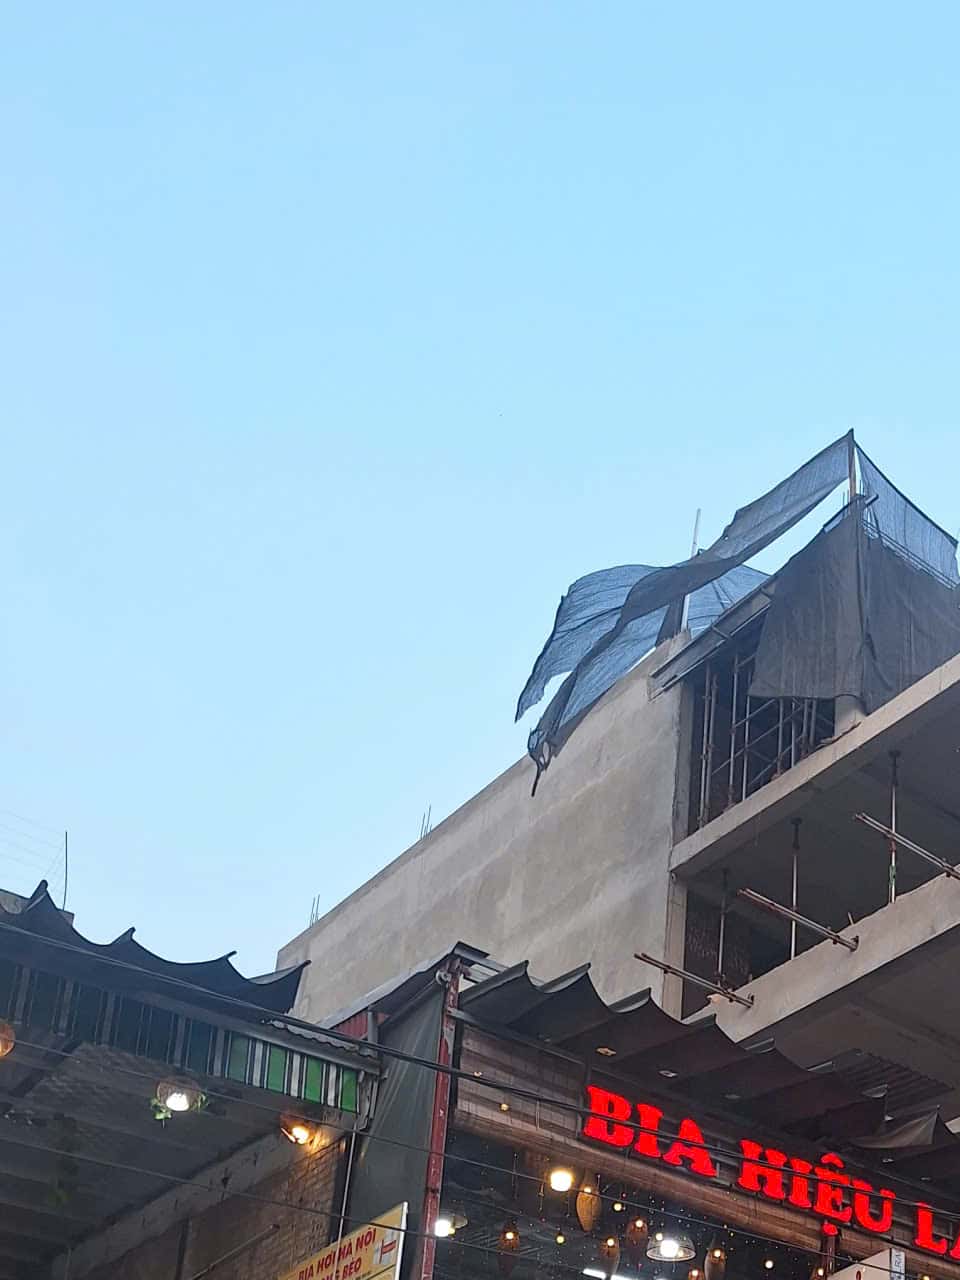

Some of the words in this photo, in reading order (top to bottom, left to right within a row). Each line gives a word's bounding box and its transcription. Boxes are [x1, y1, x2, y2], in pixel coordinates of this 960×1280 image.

[583, 1085, 717, 1177] BIA
[738, 1139, 896, 1235] HIỆU
[338, 1239, 353, 1261] HÀ
[355, 1226, 377, 1254] NỘI
